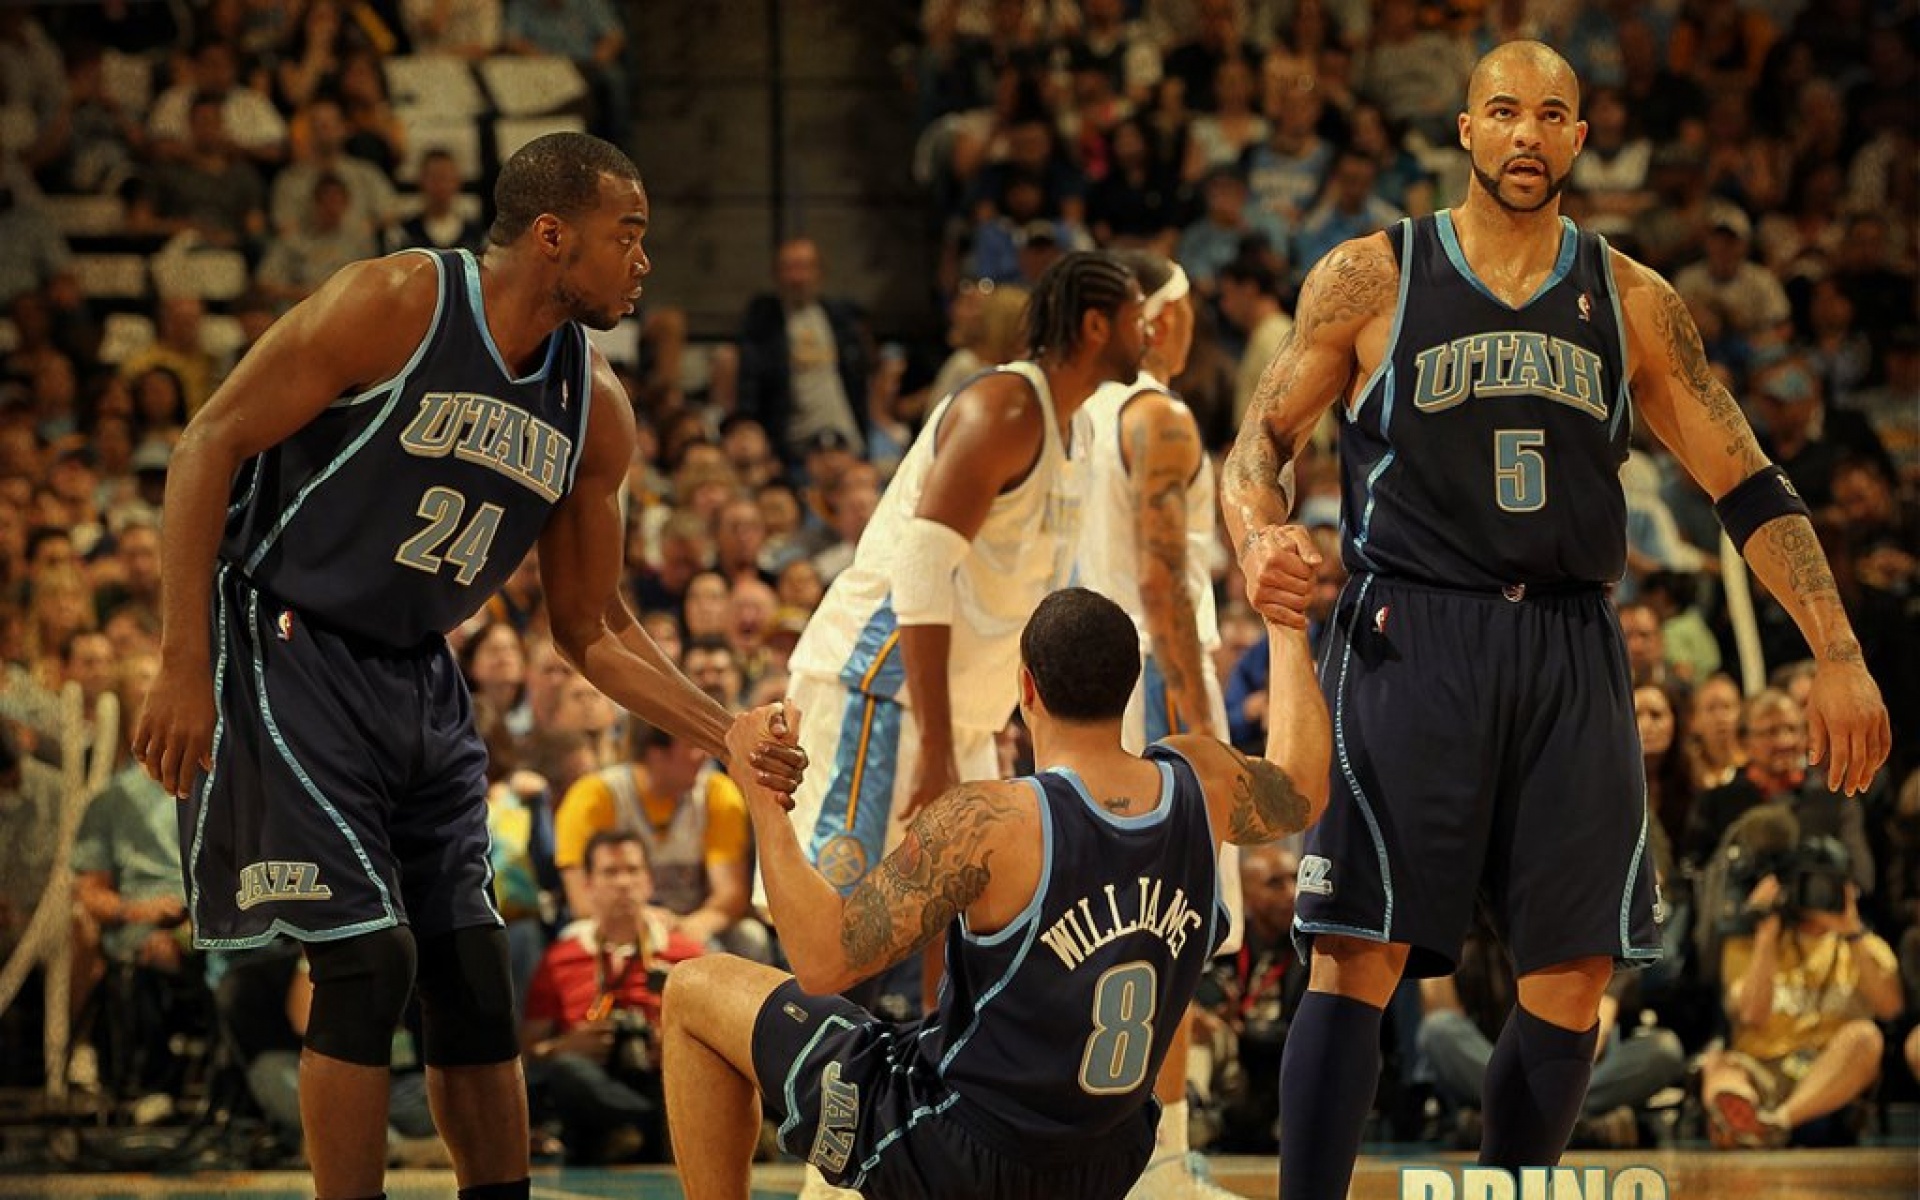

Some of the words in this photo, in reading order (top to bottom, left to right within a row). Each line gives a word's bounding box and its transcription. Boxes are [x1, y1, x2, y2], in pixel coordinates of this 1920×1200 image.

[1414, 331, 1608, 422] UTAH
[400, 392, 572, 504] UTAH
[1494, 429, 1546, 512] 5
[394, 486, 505, 586] 24
[236, 861, 333, 911] JAZZ
[1040, 876, 1202, 971] WILLIAMS
[1078, 960, 1157, 1095] 8
